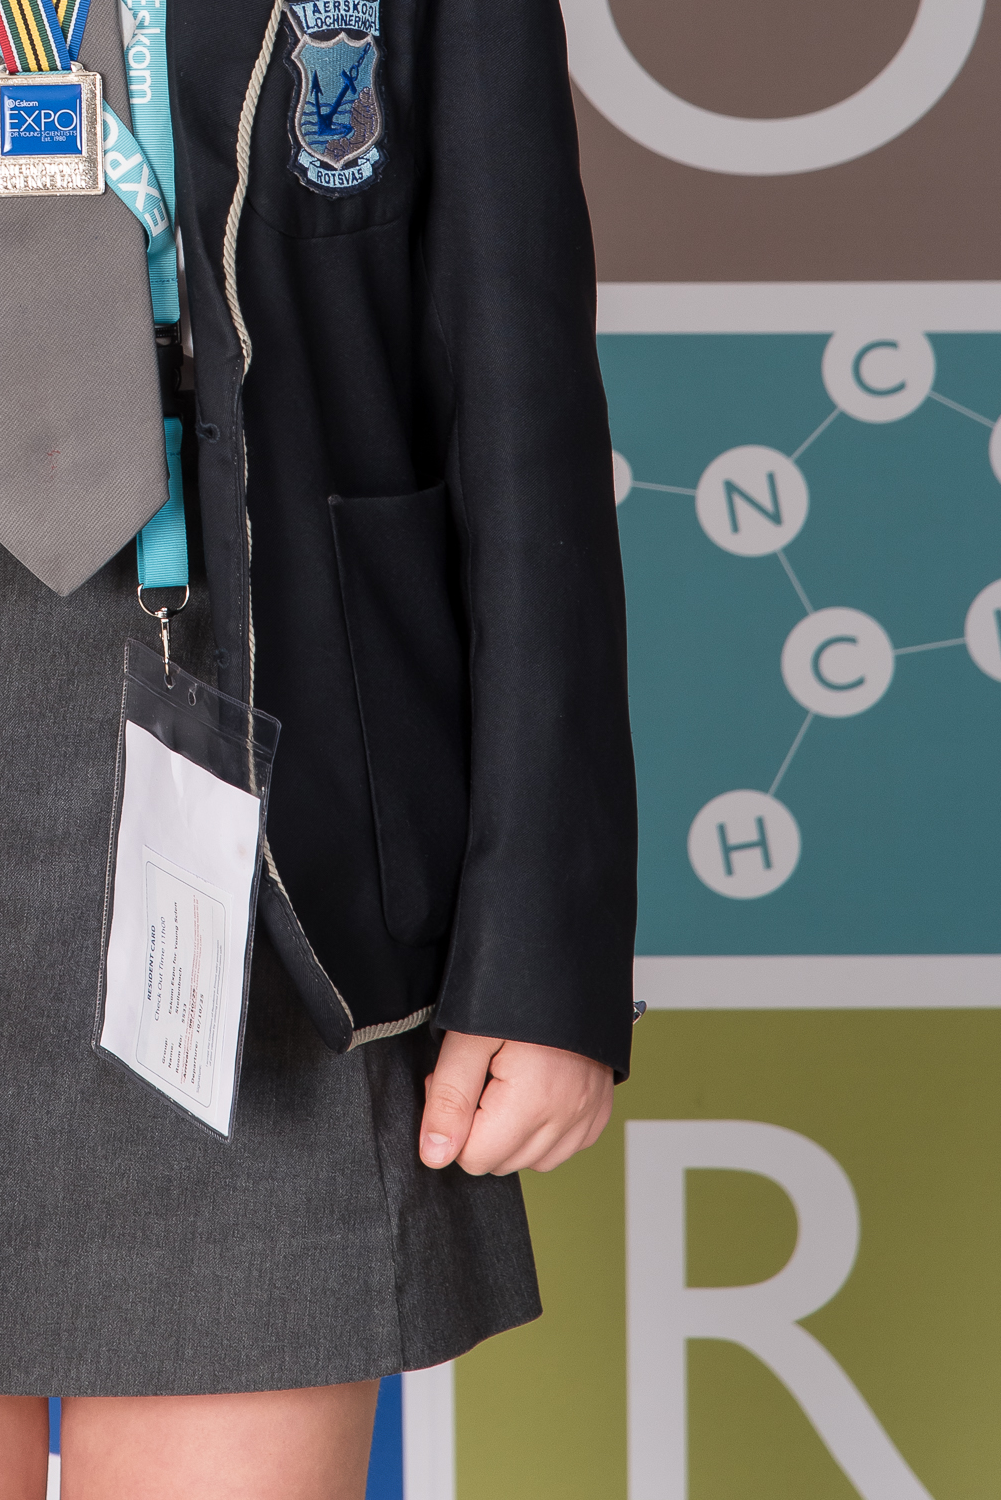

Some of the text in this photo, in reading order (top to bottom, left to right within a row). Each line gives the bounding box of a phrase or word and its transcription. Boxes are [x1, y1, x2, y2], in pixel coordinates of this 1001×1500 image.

[7, 109, 77, 131] EXPO
[103, 111, 169, 237] EXPO
[851, 338, 907, 398] C
[723, 471, 784, 535] N
[811, 634, 866, 691] C
[717, 815, 773, 878] H
[147, 953, 155, 1001] RESIDENT
[154, 992, 162, 1021] Check
[625, 1120, 932, 1500] R
